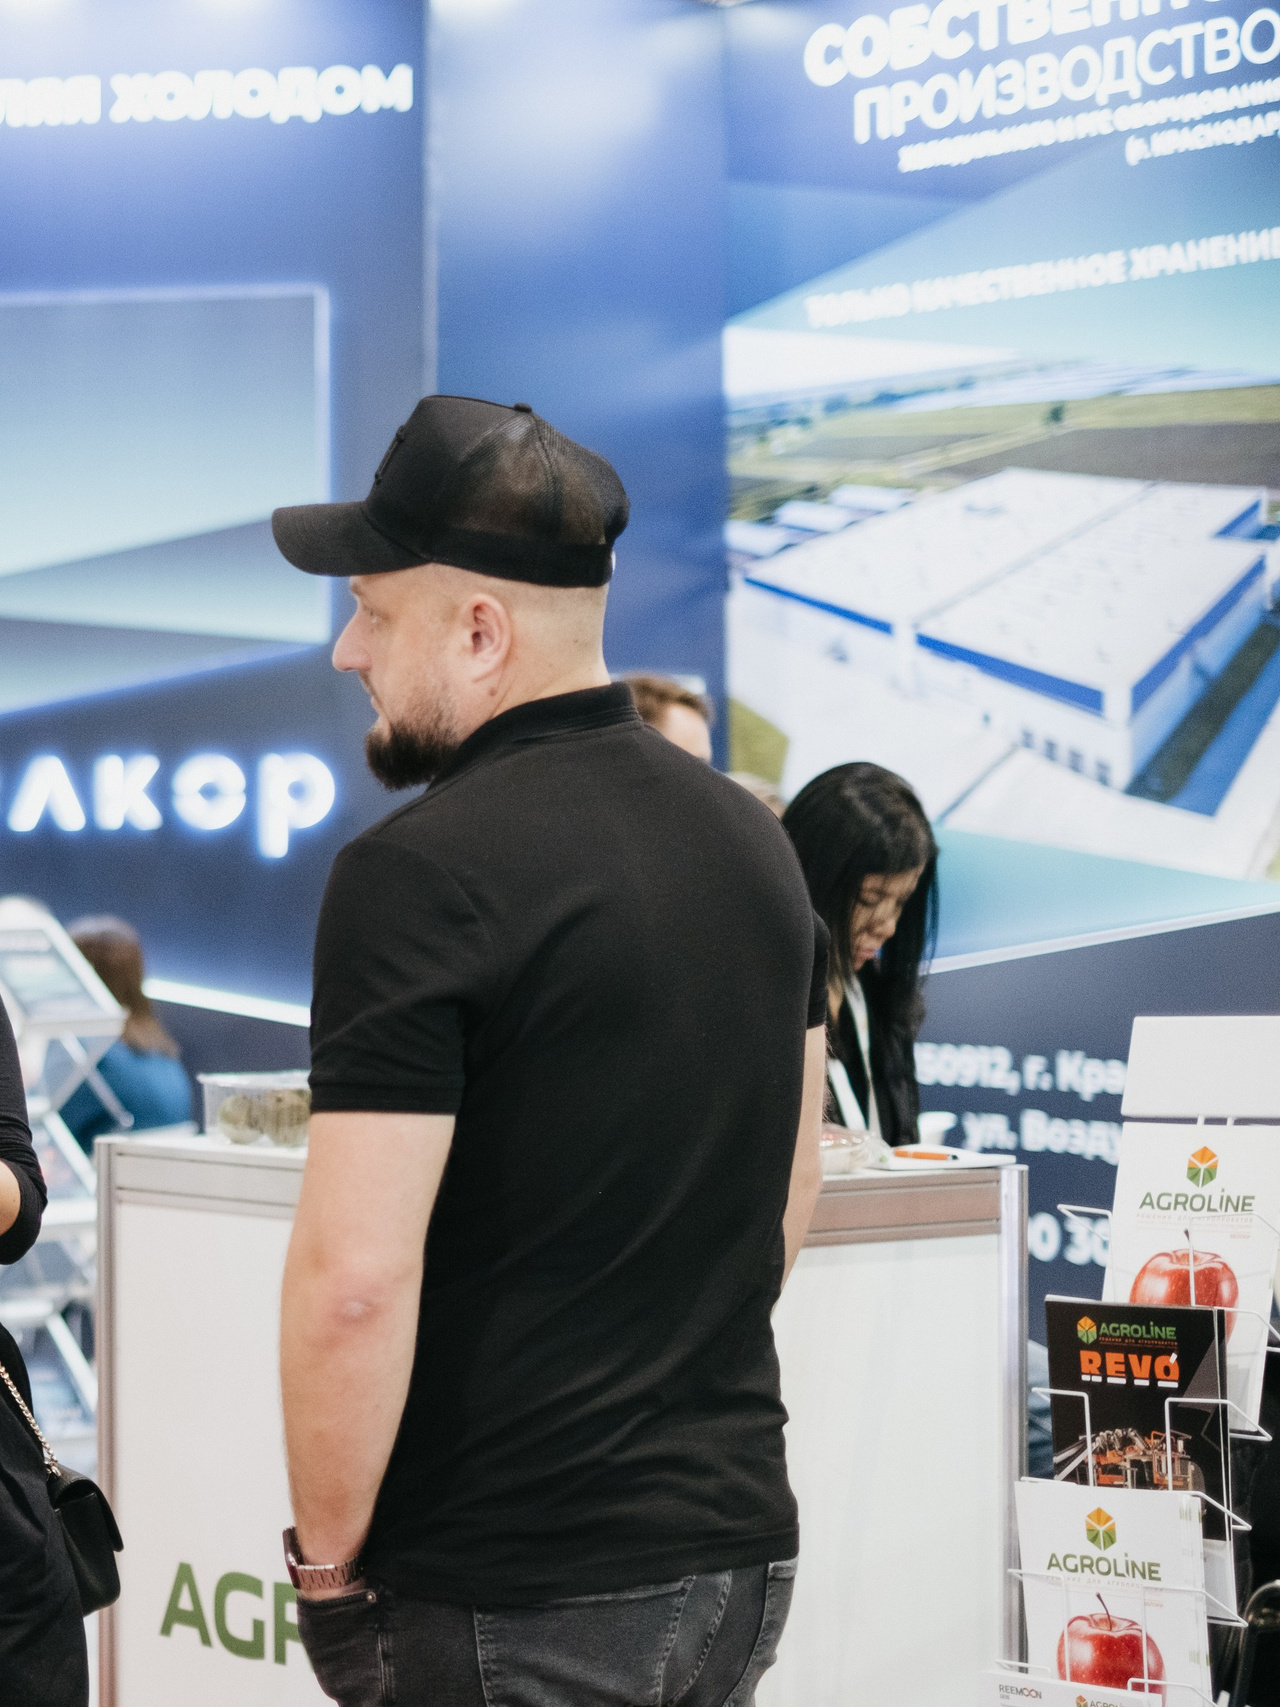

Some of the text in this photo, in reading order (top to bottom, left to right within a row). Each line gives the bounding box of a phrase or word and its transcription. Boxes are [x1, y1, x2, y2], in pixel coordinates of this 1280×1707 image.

[803, 0, 1222, 87] СОБСТВЕ
[854, 8, 1280, 144] ПРОИЗВОДСТВО
[109, 63, 414, 125] ХОЛОДОМ
[999, 1684, 1042, 1699] REEMOON
